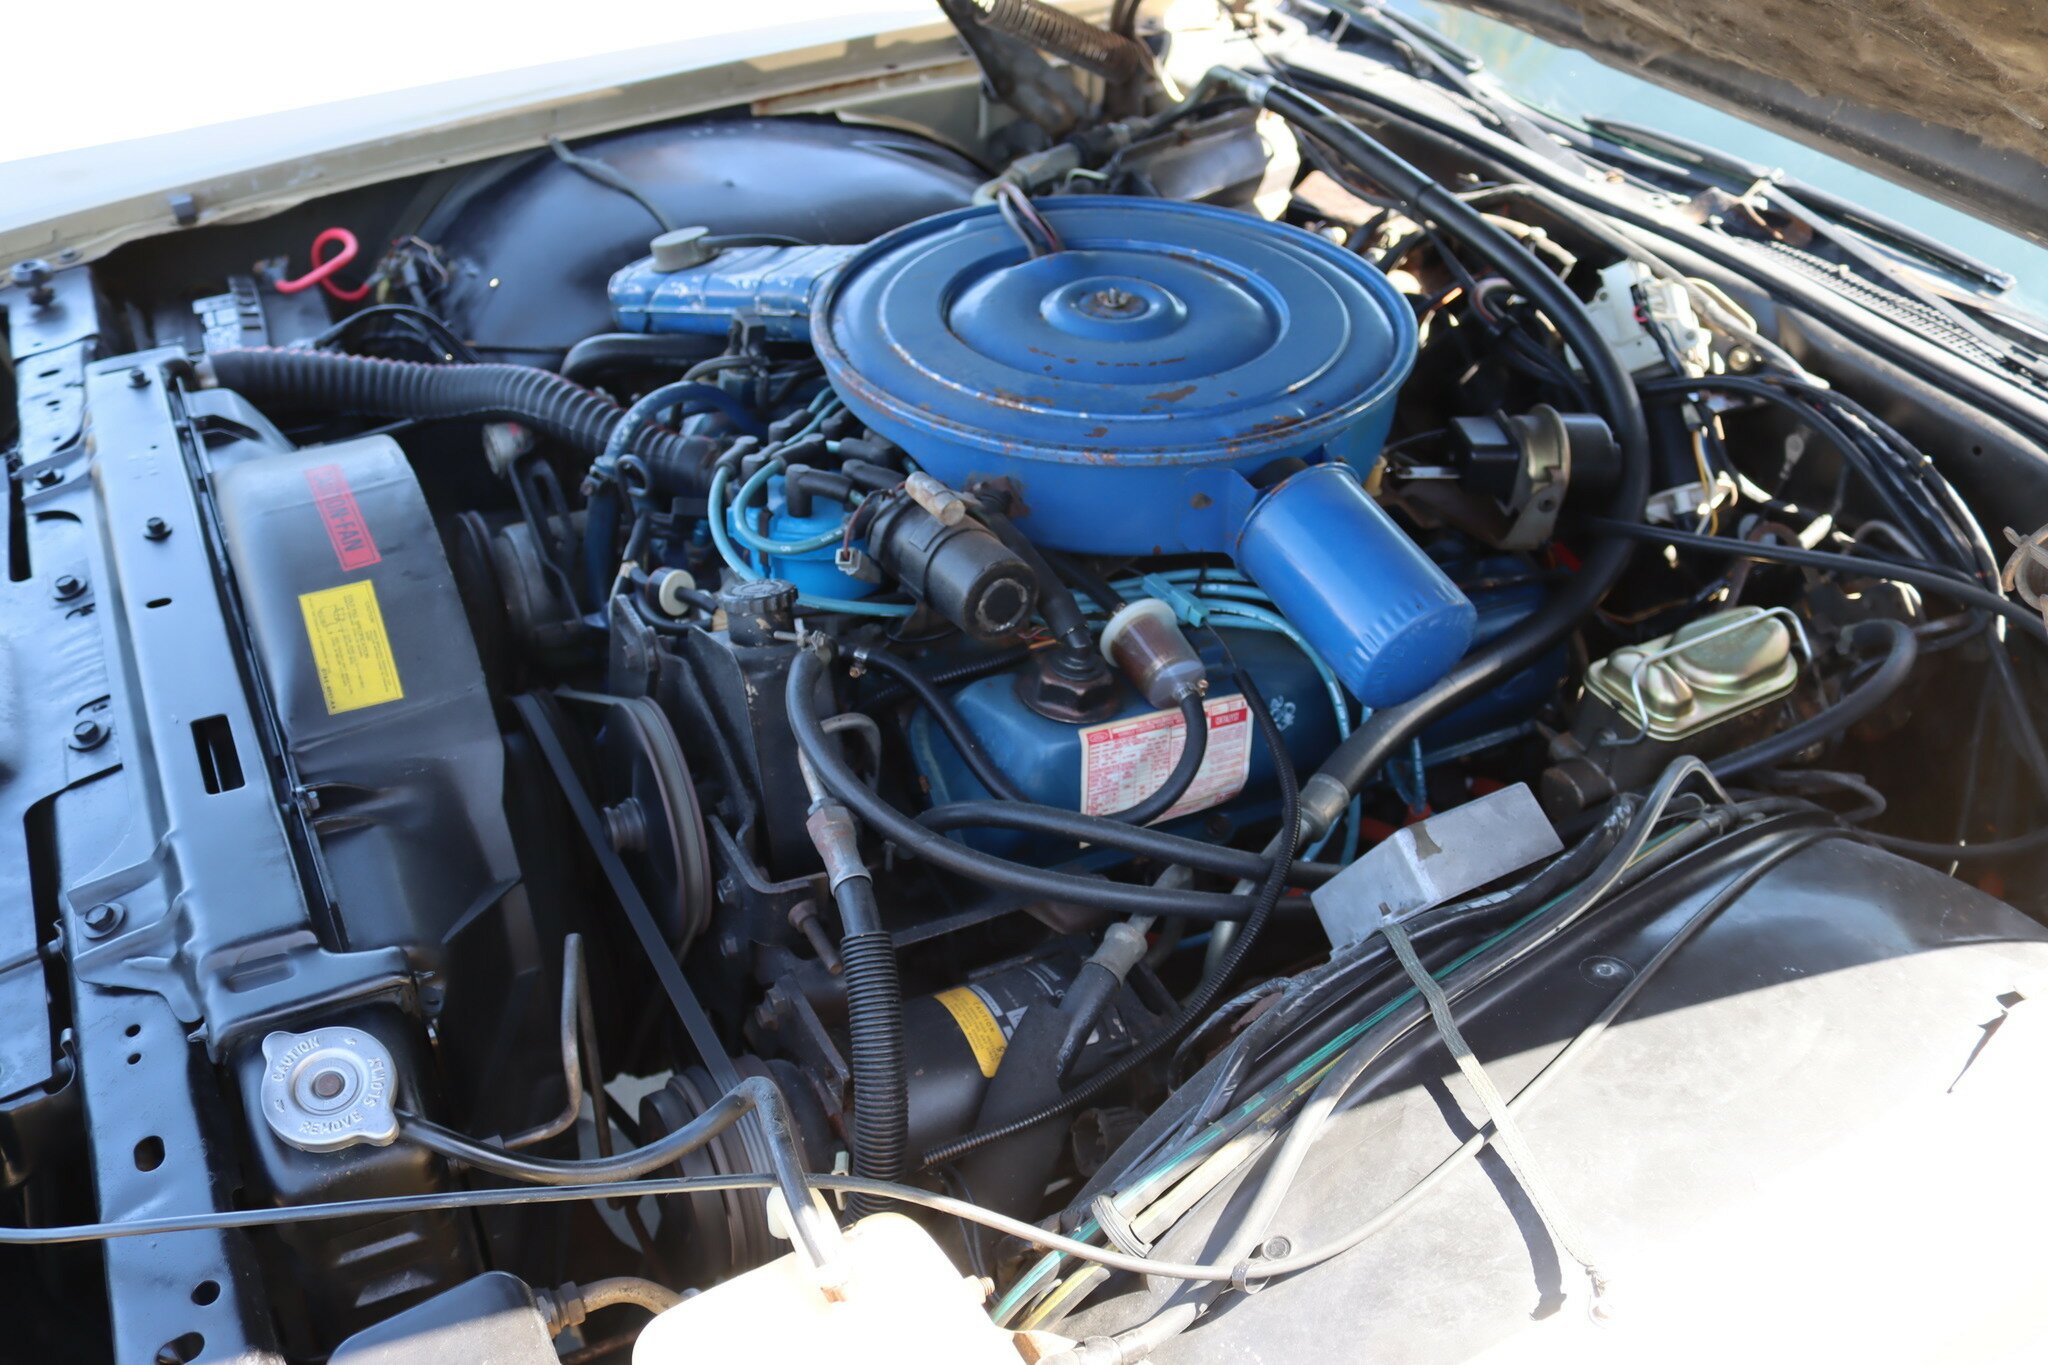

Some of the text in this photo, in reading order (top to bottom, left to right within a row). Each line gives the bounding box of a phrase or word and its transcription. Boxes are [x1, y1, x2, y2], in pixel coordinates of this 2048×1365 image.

[975, 1001, 995, 1033] CAUTION
[272, 1035, 321, 1082] CAUTION
[299, 1056, 386, 1135] REMOVE SLOWLY
